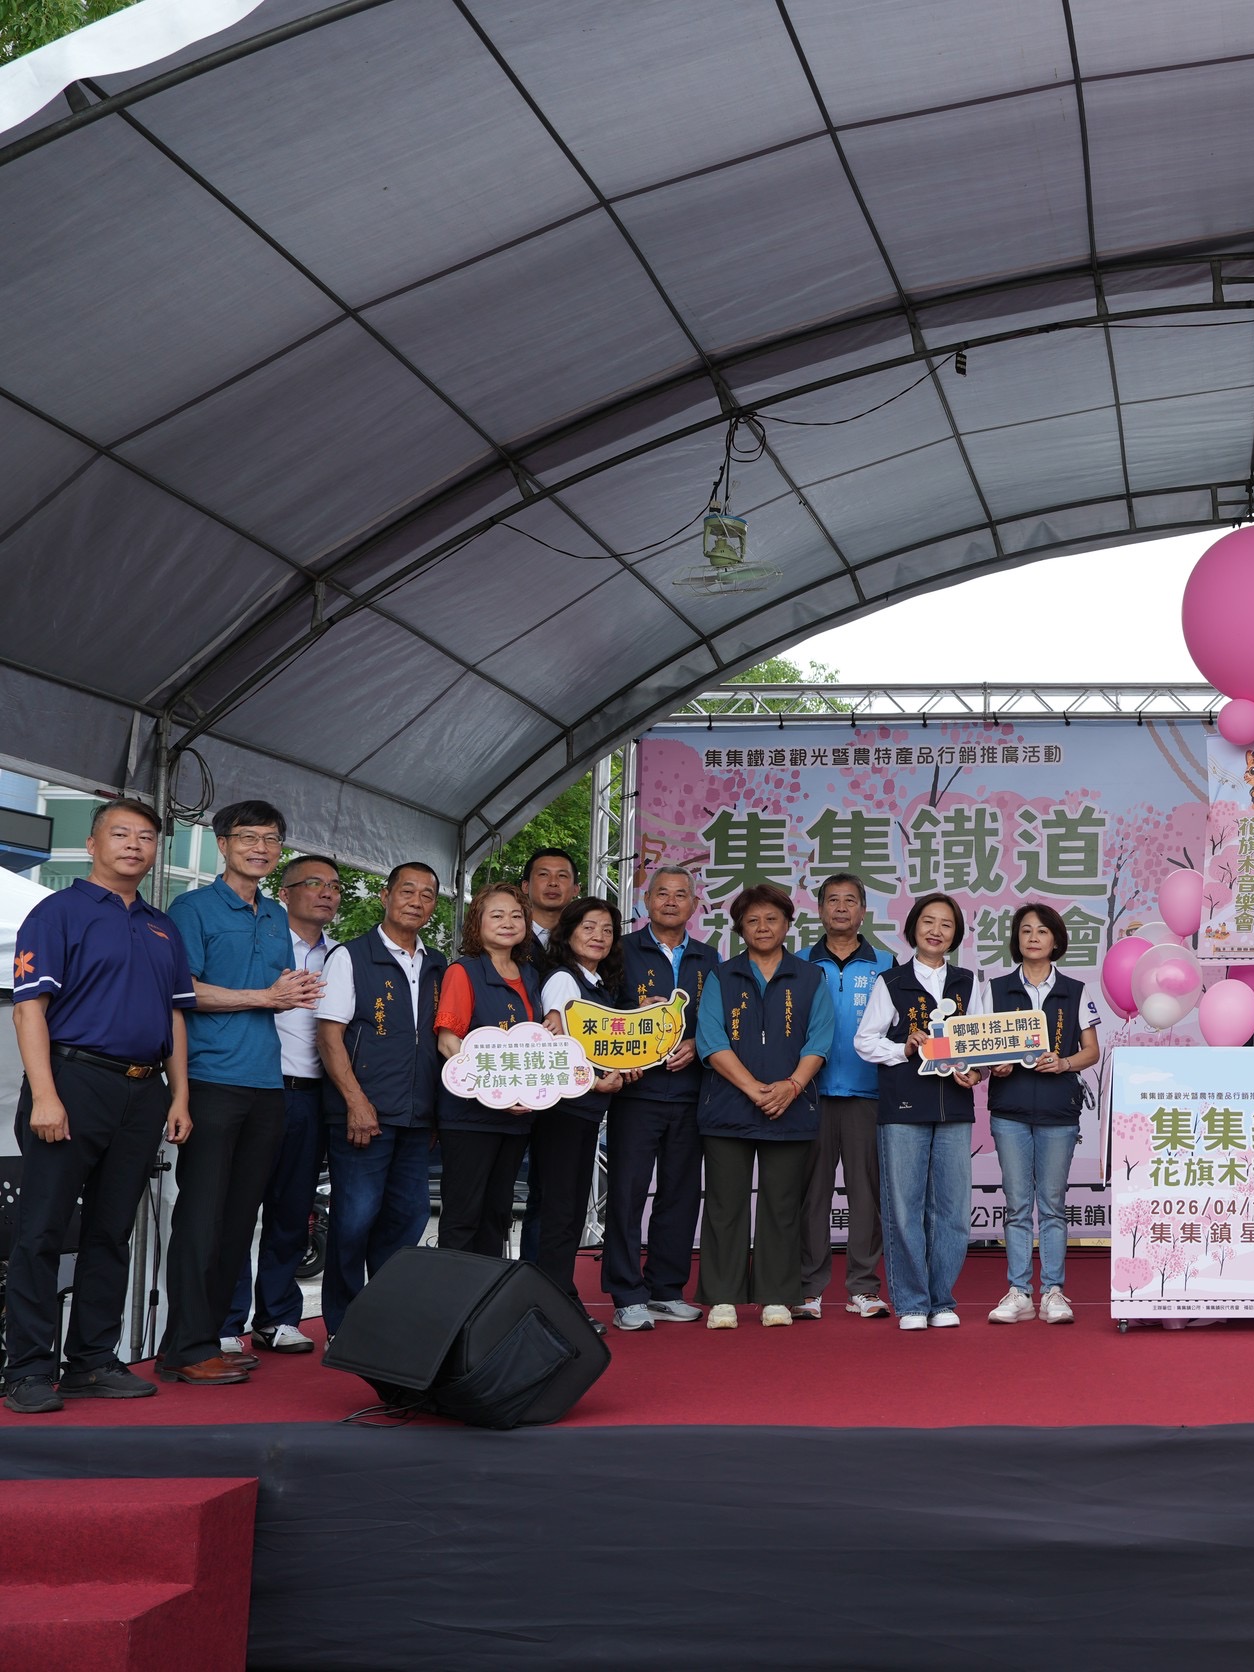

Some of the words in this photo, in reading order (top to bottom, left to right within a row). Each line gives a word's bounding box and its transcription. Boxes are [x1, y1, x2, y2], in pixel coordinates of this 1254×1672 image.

[704, 745, 1063, 767] 集集鐵道觀光暨農特產品行銷推廣活動
[702, 806, 1108, 899] 集集鐵道
[647, 969, 656, 987] 代表
[385, 980, 394, 1001] 代表
[741, 991, 749, 1010] 代表
[954, 1036, 1021, 1054] 春天的列車
[475, 1050, 570, 1072] 集集鐵道
[476, 1071, 570, 1089] 花旗木音樂會
